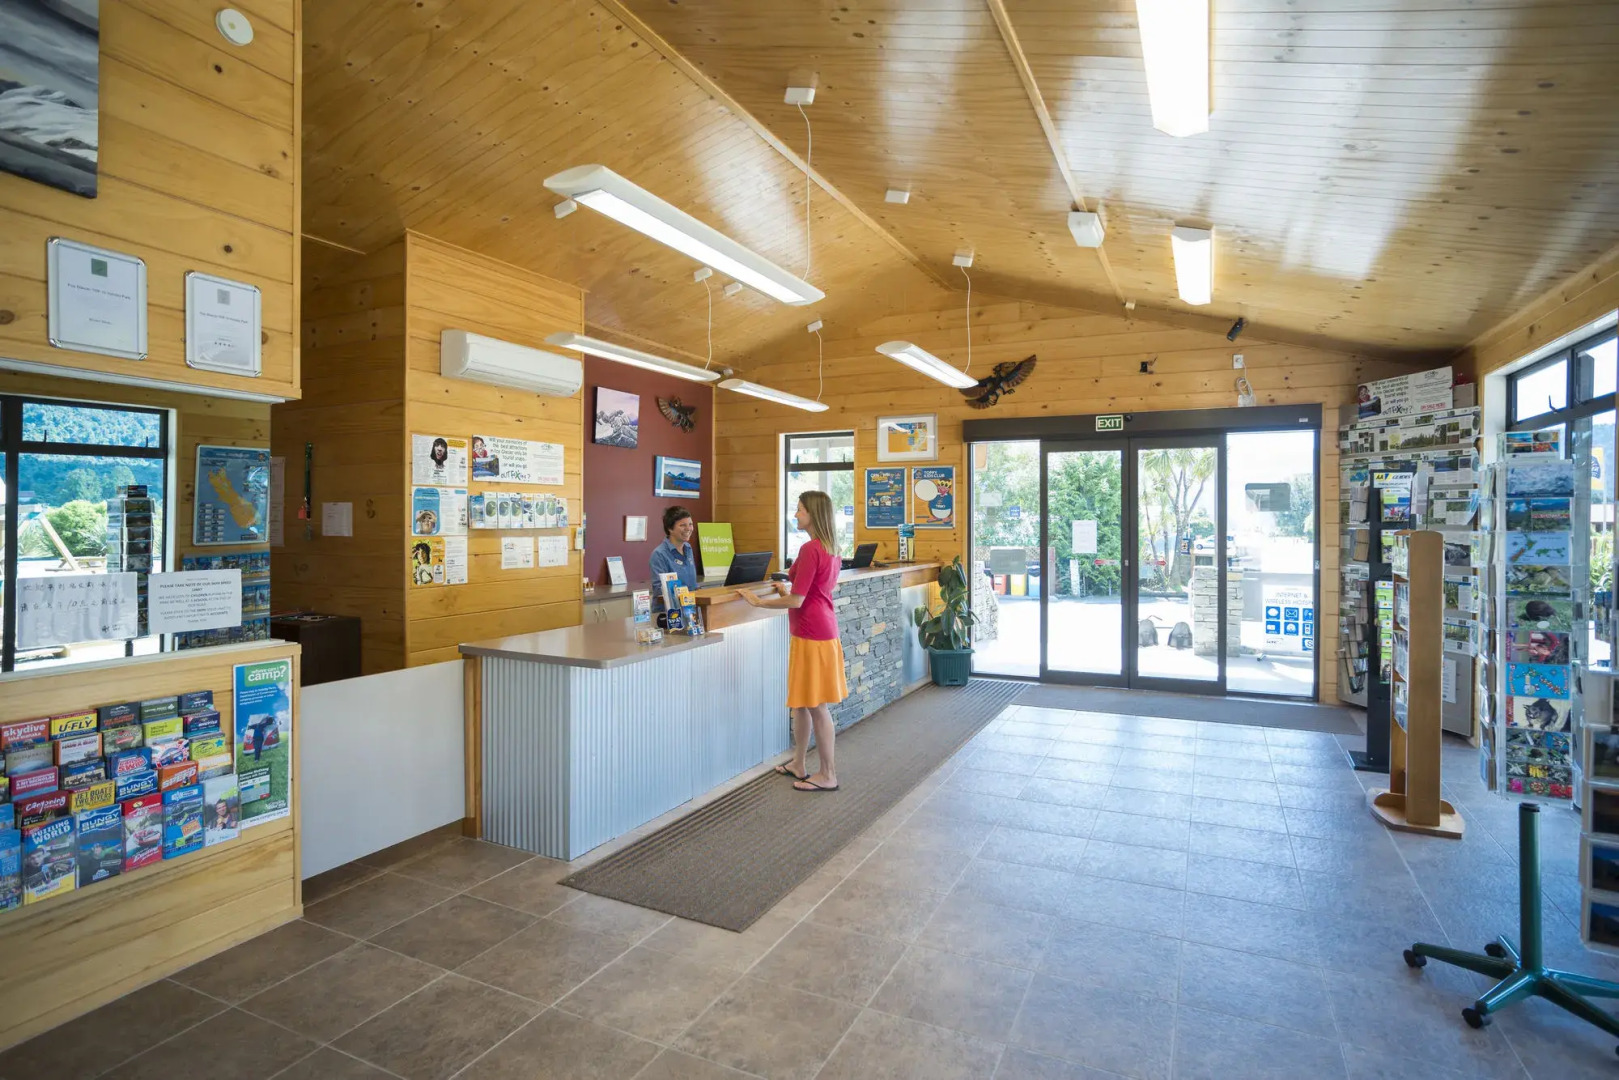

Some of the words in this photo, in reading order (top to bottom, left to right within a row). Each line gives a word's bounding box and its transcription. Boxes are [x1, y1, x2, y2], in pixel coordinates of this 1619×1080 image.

[1098, 418, 1121, 428] EXIT
[248, 666, 286, 682] camp?
[4, 723, 46, 738] skydive
[119, 778, 154, 793] BUNGY
[32, 820, 70, 836] PUZZLING
[82, 812, 120, 828] BUNGY
[33, 825, 70, 844] WORLD
